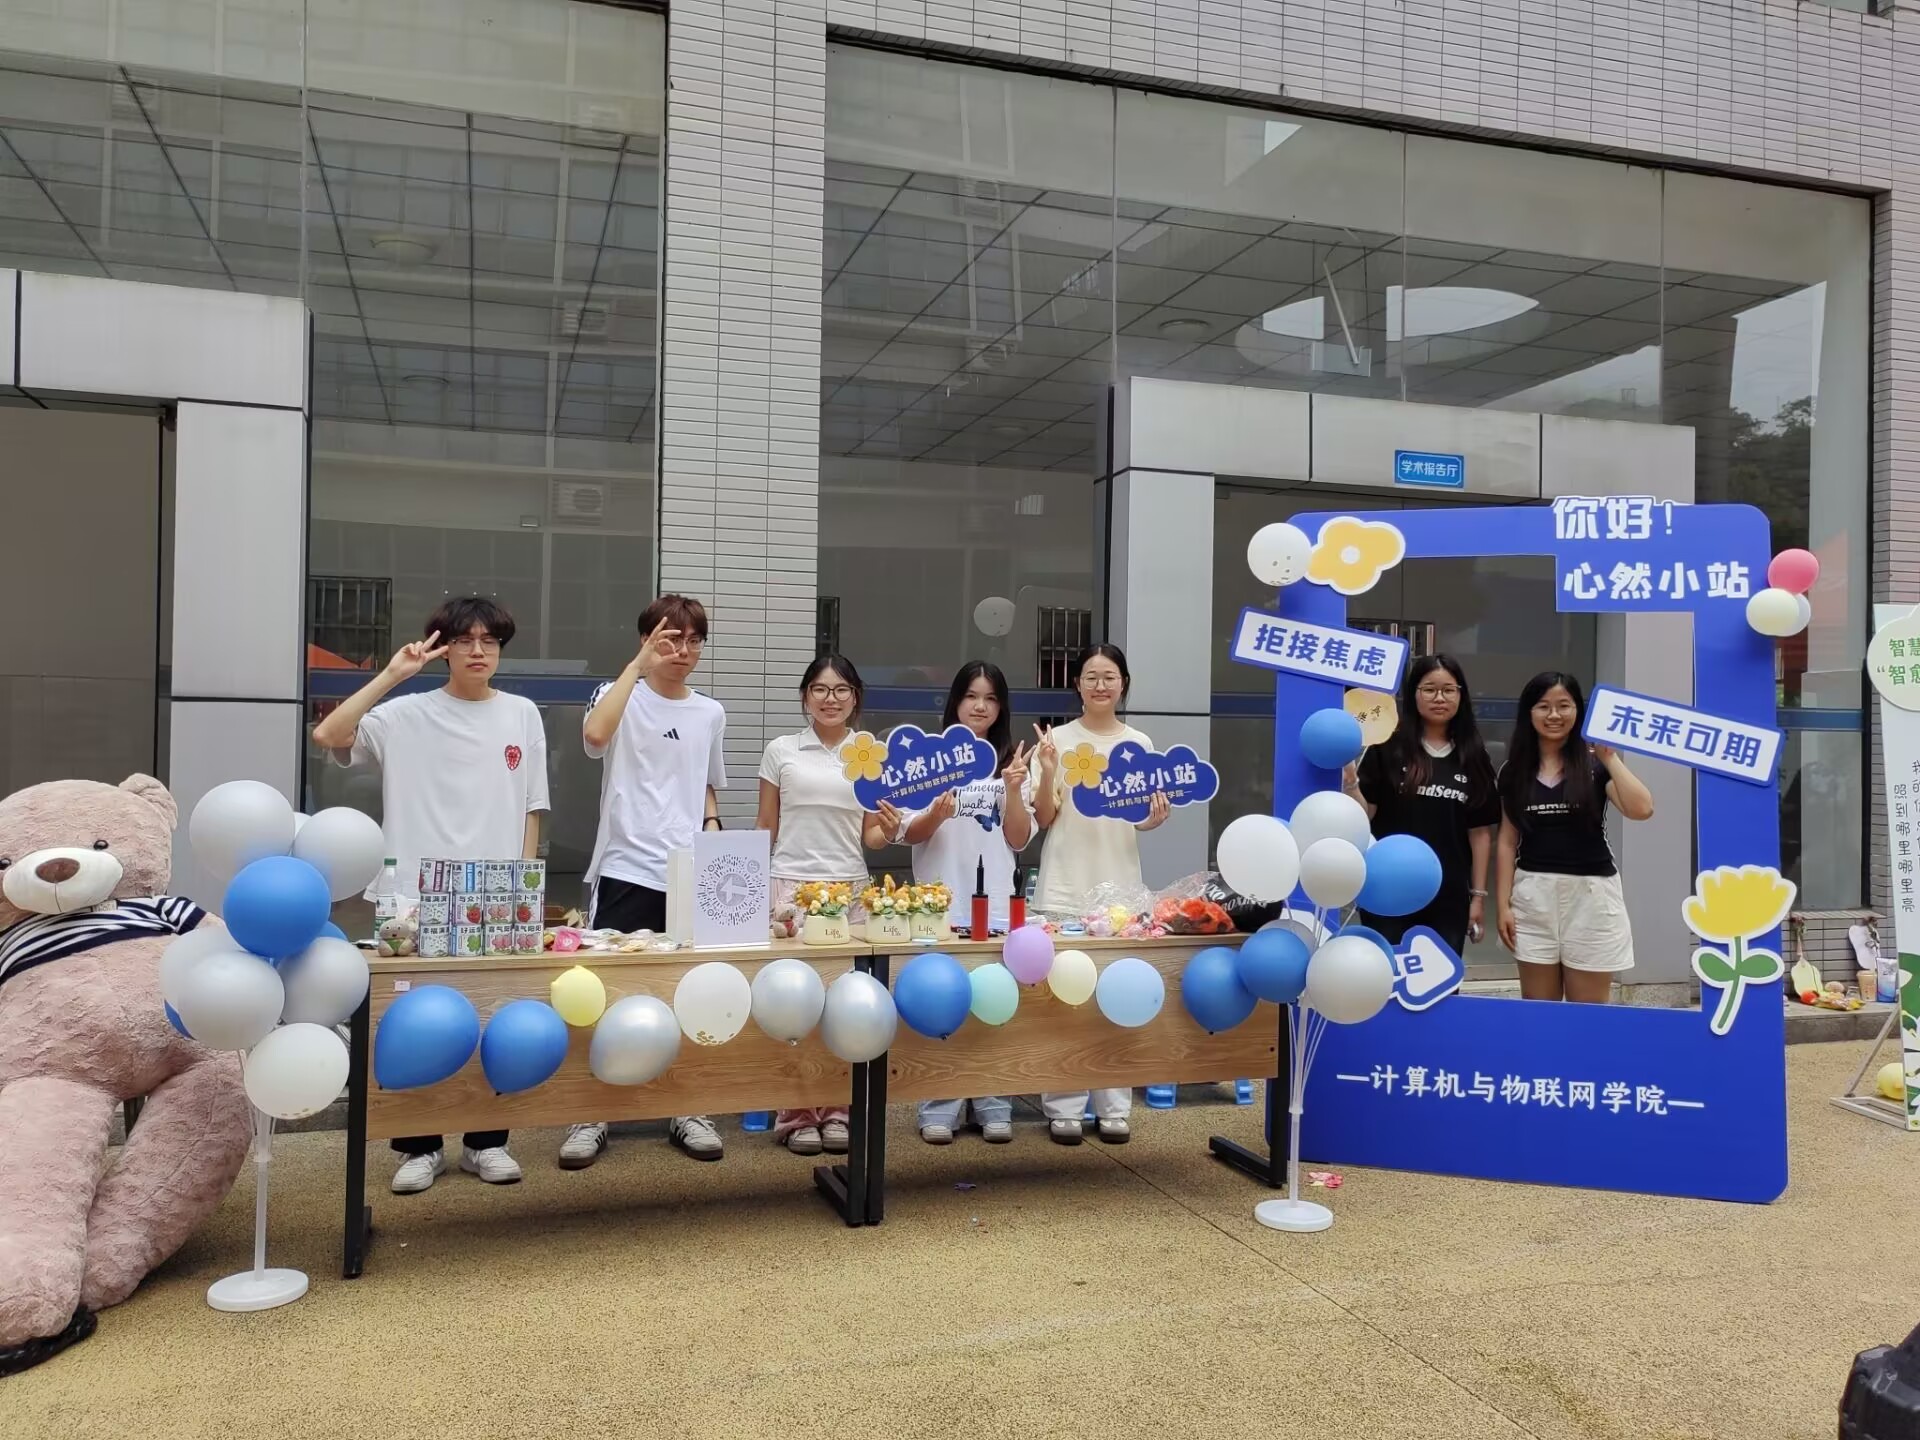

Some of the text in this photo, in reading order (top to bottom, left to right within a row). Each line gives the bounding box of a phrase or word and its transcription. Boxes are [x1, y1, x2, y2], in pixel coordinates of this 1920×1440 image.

[1400, 459, 1459, 478] 学术报告厅
[1563, 561, 1750, 600] 心然小站
[1253, 623, 1387, 676] 拒接焦虑
[1606, 704, 1762, 769] 未来可期
[881, 742, 977, 788] 心然小站
[1099, 762, 1198, 798] 心然小站
[1893, 783, 1916, 913] 照到哪里哪里亮
[825, 928, 840, 936] Life
[883, 925, 898, 934] Life
[918, 924, 933, 933] Life
